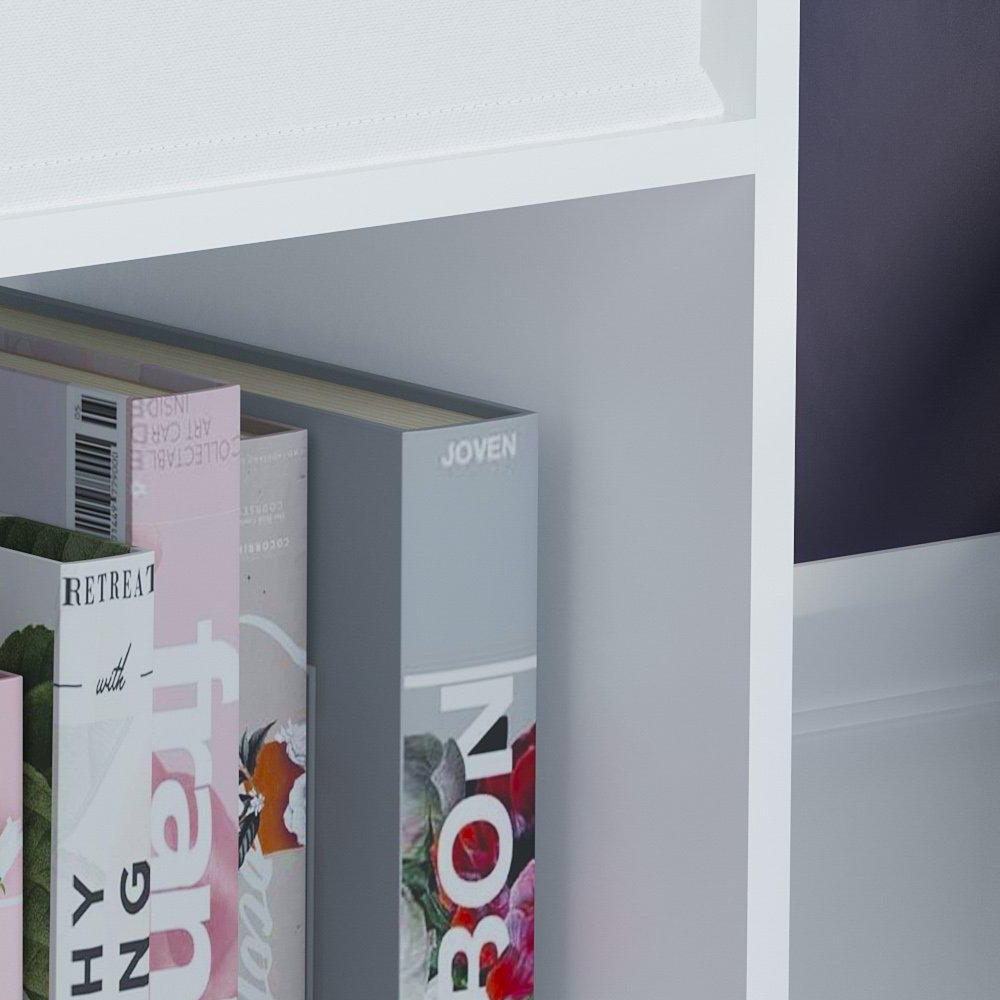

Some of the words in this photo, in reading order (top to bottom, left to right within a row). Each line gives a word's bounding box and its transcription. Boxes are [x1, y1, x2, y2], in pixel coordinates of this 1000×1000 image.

[188, 418, 211, 441] ART
[441, 431, 517, 467] JOVEN
[63, 563, 155, 606] RETREAT
[96, 643, 132, 695] with
